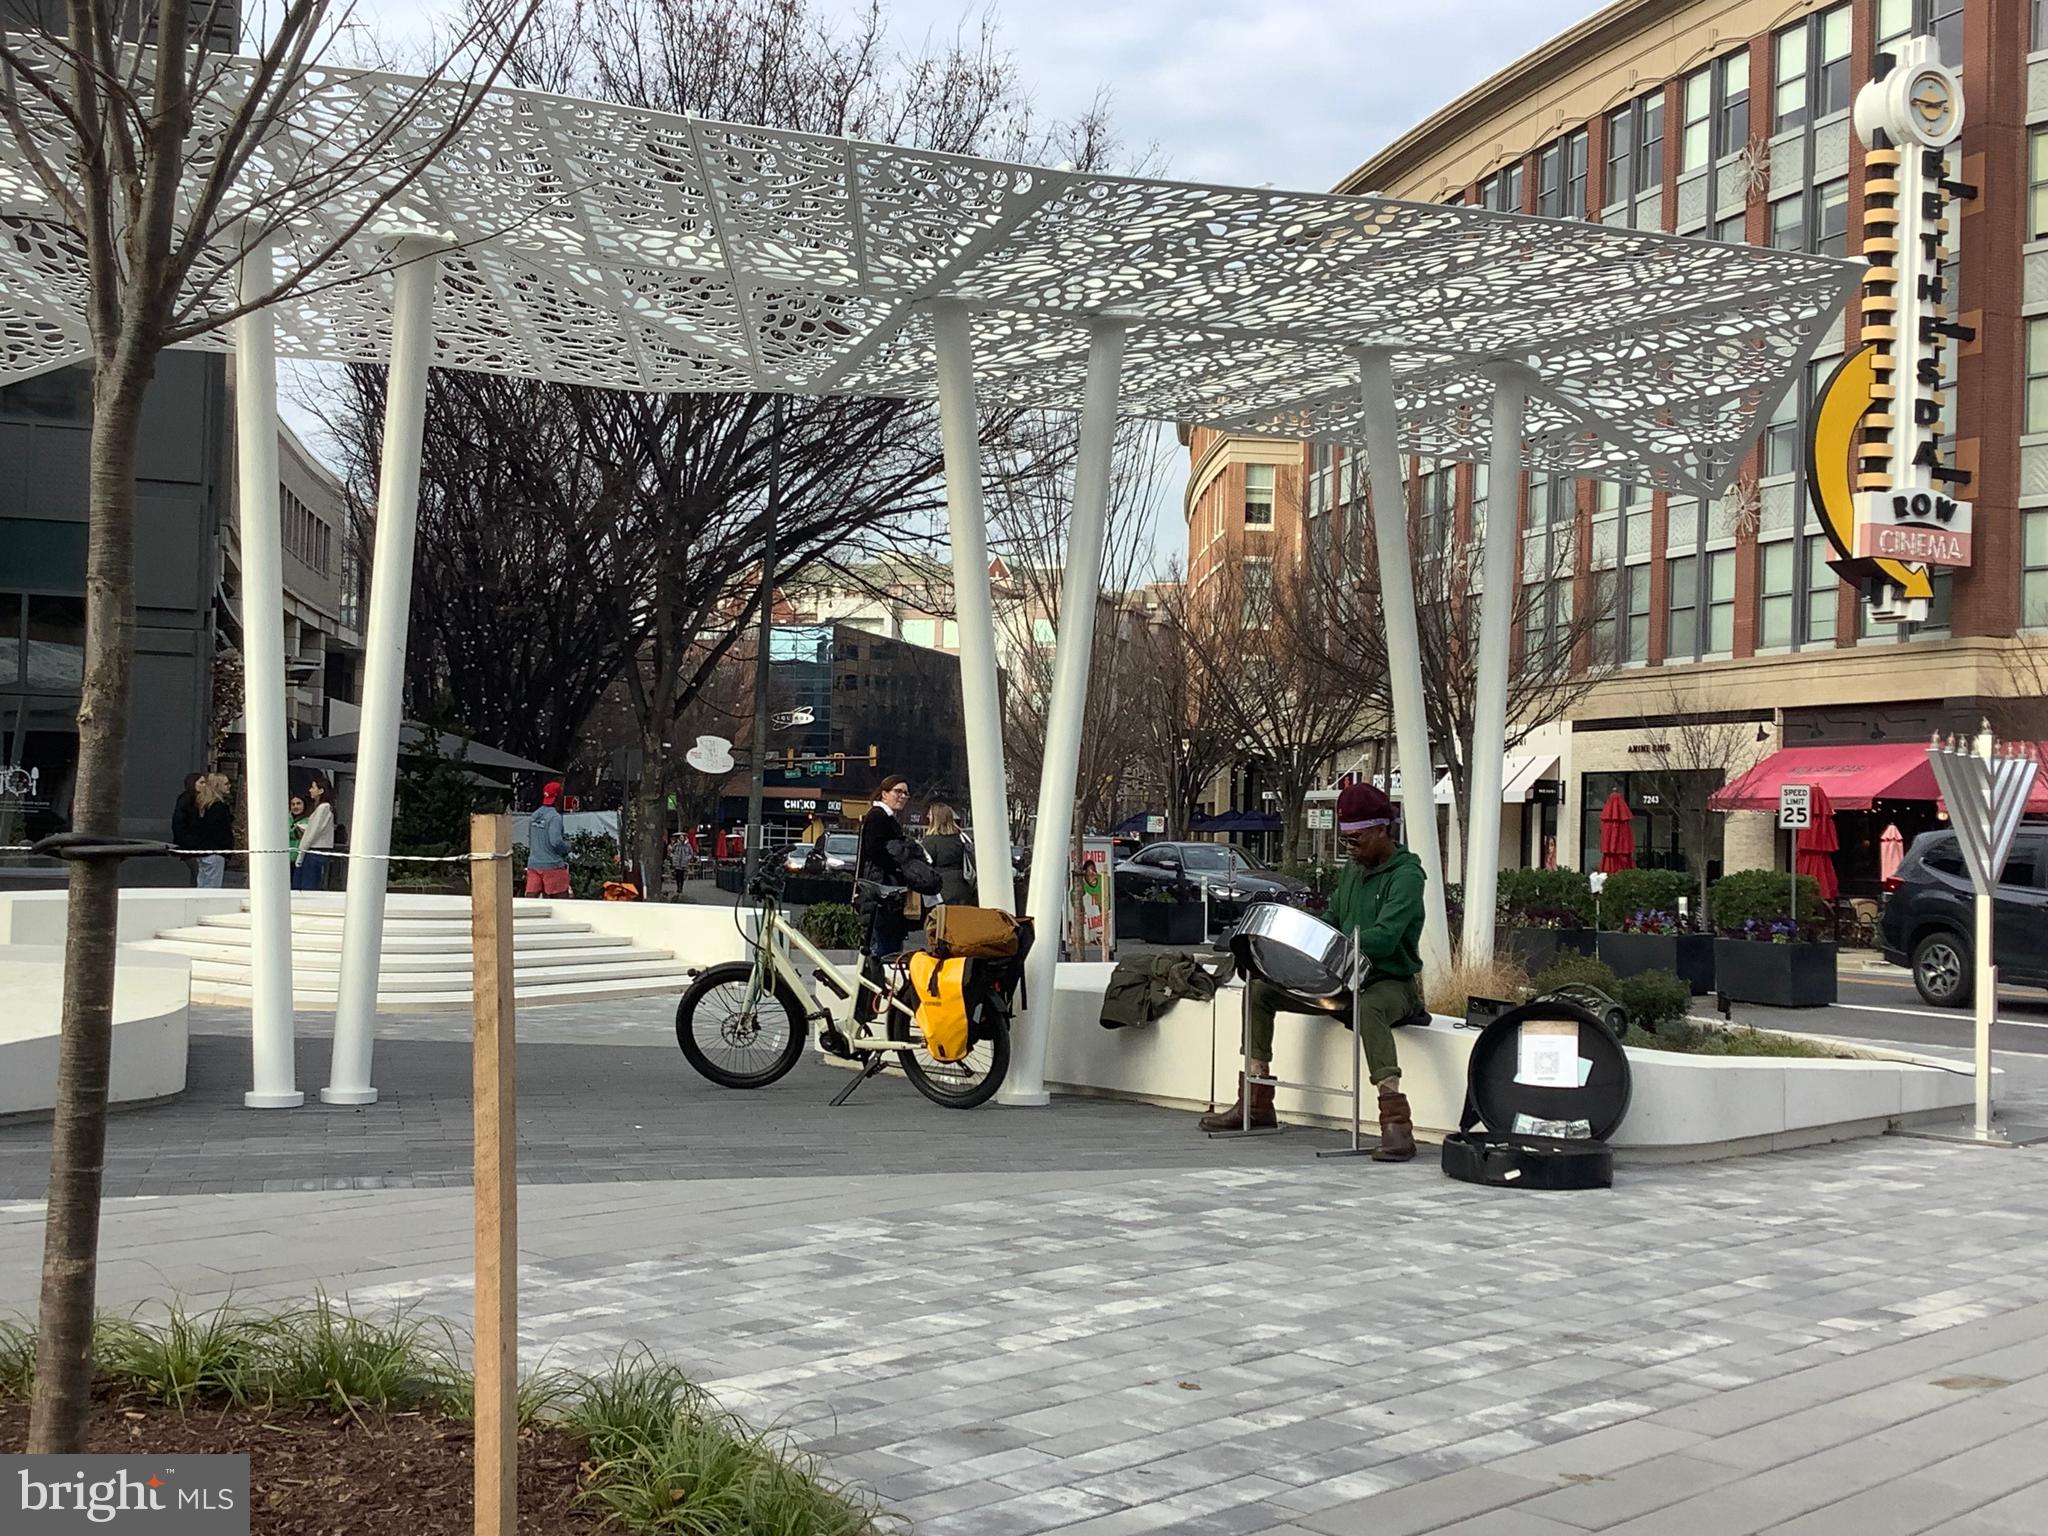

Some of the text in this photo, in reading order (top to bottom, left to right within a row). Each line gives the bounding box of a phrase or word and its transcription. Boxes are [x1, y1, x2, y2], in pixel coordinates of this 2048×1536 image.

[1912, 150, 1944, 465] BETHESDA
[1893, 493, 1958, 522] ROW
[1879, 529, 1963, 560] CINEMA
[1783, 789, 1808, 797] SPEED
[1786, 798, 1805, 806] LIMIT
[1783, 807, 1808, 823] 25
